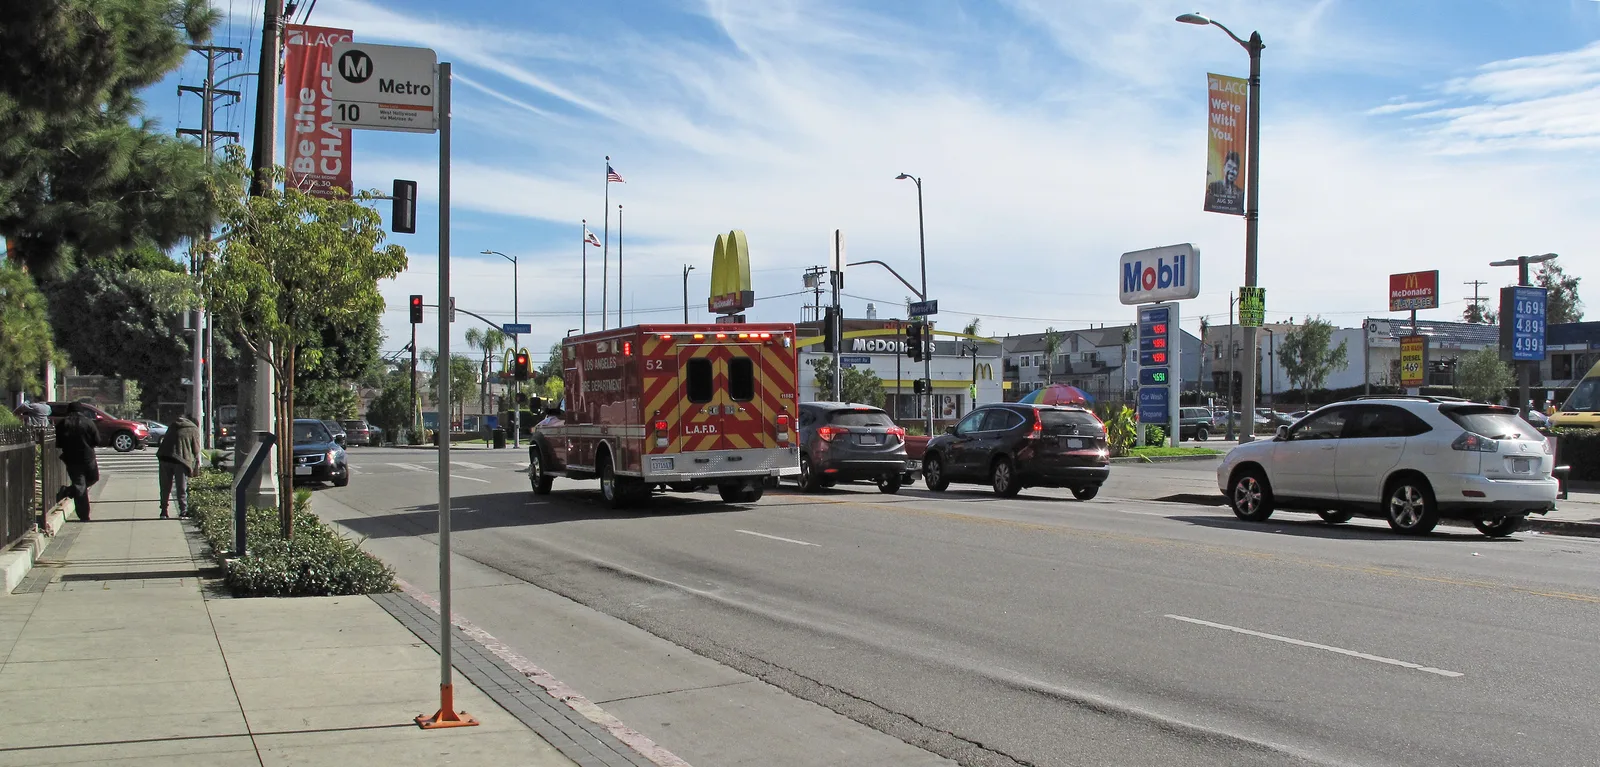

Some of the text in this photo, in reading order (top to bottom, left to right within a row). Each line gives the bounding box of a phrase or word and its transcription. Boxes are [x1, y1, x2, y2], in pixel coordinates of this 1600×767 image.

[379, 78, 431, 96] Metro
[1219, 80, 1246, 96] LACC
[337, 103, 360, 122] 10
[1211, 98, 1241, 113] We're
[1211, 112, 1237, 127] With
[293, 87, 316, 174] Be the
[1211, 127, 1233, 142] You.
[1123, 254, 1186, 294] Mobil
[1391, 287, 1432, 298] McDonald's
[1516, 301, 1539, 315] 4.69
[1516, 318, 1538, 333] 4.89
[1515, 338, 1538, 351] 4.99
[584, 357, 617, 371] LOS ANGELES
[646, 359, 663, 370] 52
[592, 379, 622, 392] DEPARTMENT
[1141, 393, 1150, 401] Car
[1143, 409, 1163, 418] Propane
[685, 424, 718, 434] L.A.F.D.
